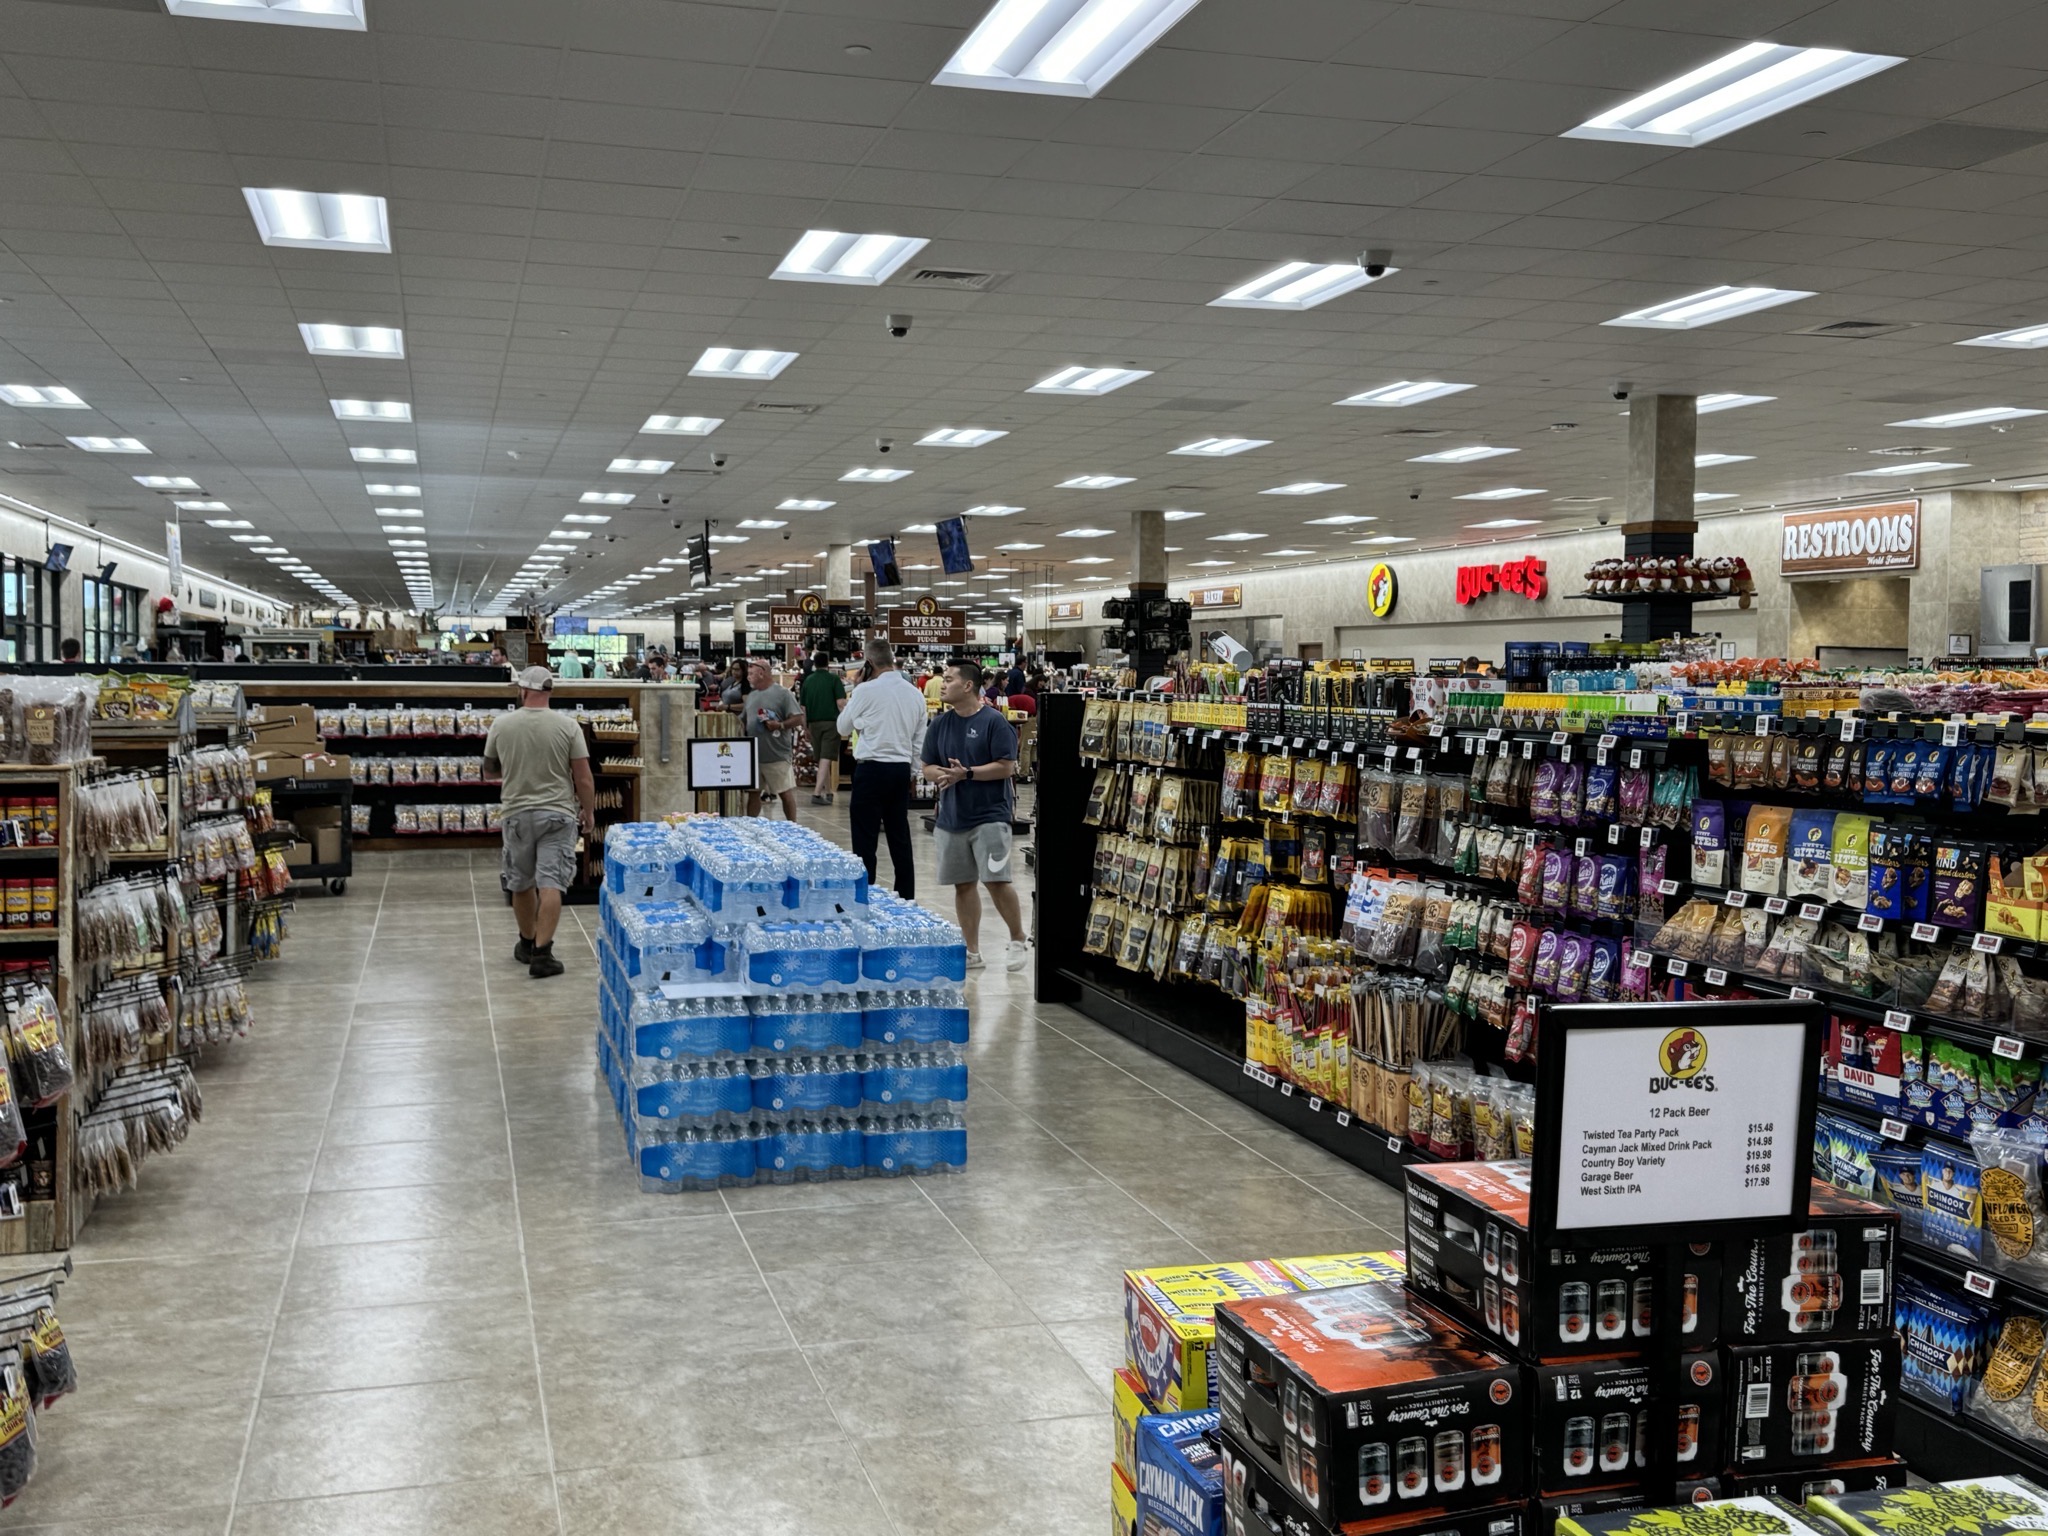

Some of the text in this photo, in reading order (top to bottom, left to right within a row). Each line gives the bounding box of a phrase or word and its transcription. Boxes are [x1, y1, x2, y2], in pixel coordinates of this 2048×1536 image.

[1782, 514, 1913, 560] RESTROOMS
[1866, 556, 1884, 566] World
[1456, 555, 1547, 605] BUC-EE'S
[773, 614, 803, 625] TEXAS
[902, 616, 953, 628] SWEETS
[904, 629, 951, 637] SUGARED NUTS
[1694, 836, 1719, 847] ITES
[1793, 849, 1831, 860] BITES
[1843, 1067, 1875, 1086] DAVID
[1649, 1075, 1715, 1094] BUC-EE'S
[1911, 1083, 1924, 1092] BLUE
[1845, 1086, 1875, 1100] ORIGINAL
[1906, 1088, 1932, 1098] DIAMOND
[1949, 1094, 1962, 1102] BLUE
[1944, 1099, 1965, 1108] DIAMON
[1649, 1106, 1710, 1119] 12 Pack Beer
[1970, 1111, 1997, 1121] DIAMOND
[1975, 1106, 1989, 1115] BLUE
[2029, 1118, 2043, 1127] BLUE
[1582, 1123, 1774, 1141] Twisted Tea Party Pack $15.48
[1582, 1136, 1773, 1156] Cayman Jack Mixed Drink Pack $14.98
[1581, 1150, 1772, 1170] Country Boy Variety $19.98
[1580, 1163, 1771, 1185] Garage Beer $16.98
[1580, 1177, 1770, 1196] West Sixth IPA $17.98
[1894, 1192, 1923, 1204] CHINO
[1929, 1190, 1964, 1210] CHINOOK
[1564, 1254, 1576, 1264] 12
[1590, 1251, 1651, 1265] The Country
[1743, 1240, 1758, 1335] For The Coun
[1944, 1308, 1959, 1318] EVER
[1194, 1340, 1205, 1352] 12
[1910, 1338, 1945, 1361] CHINOOK
[1766, 1355, 1772, 1364] 12
[1206, 1350, 1219, 1409] PARTY PA
[1570, 1389, 1582, 1400] 12
[1594, 1385, 1636, 1400] Country
[1860, 1377, 1869, 1406] VARIETY
[1424, 1398, 1448, 1407] VARIETY
[1861, 1348, 1882, 1453] For The Country
[1386, 1401, 1470, 1424] For The Country
[1361, 1415, 1374, 1426] 12
[1770, 1485, 1777, 1494] 12
[1140, 1461, 1205, 1533] CAYMAN JACK
[1180, 1517, 1194, 1535] PACK
